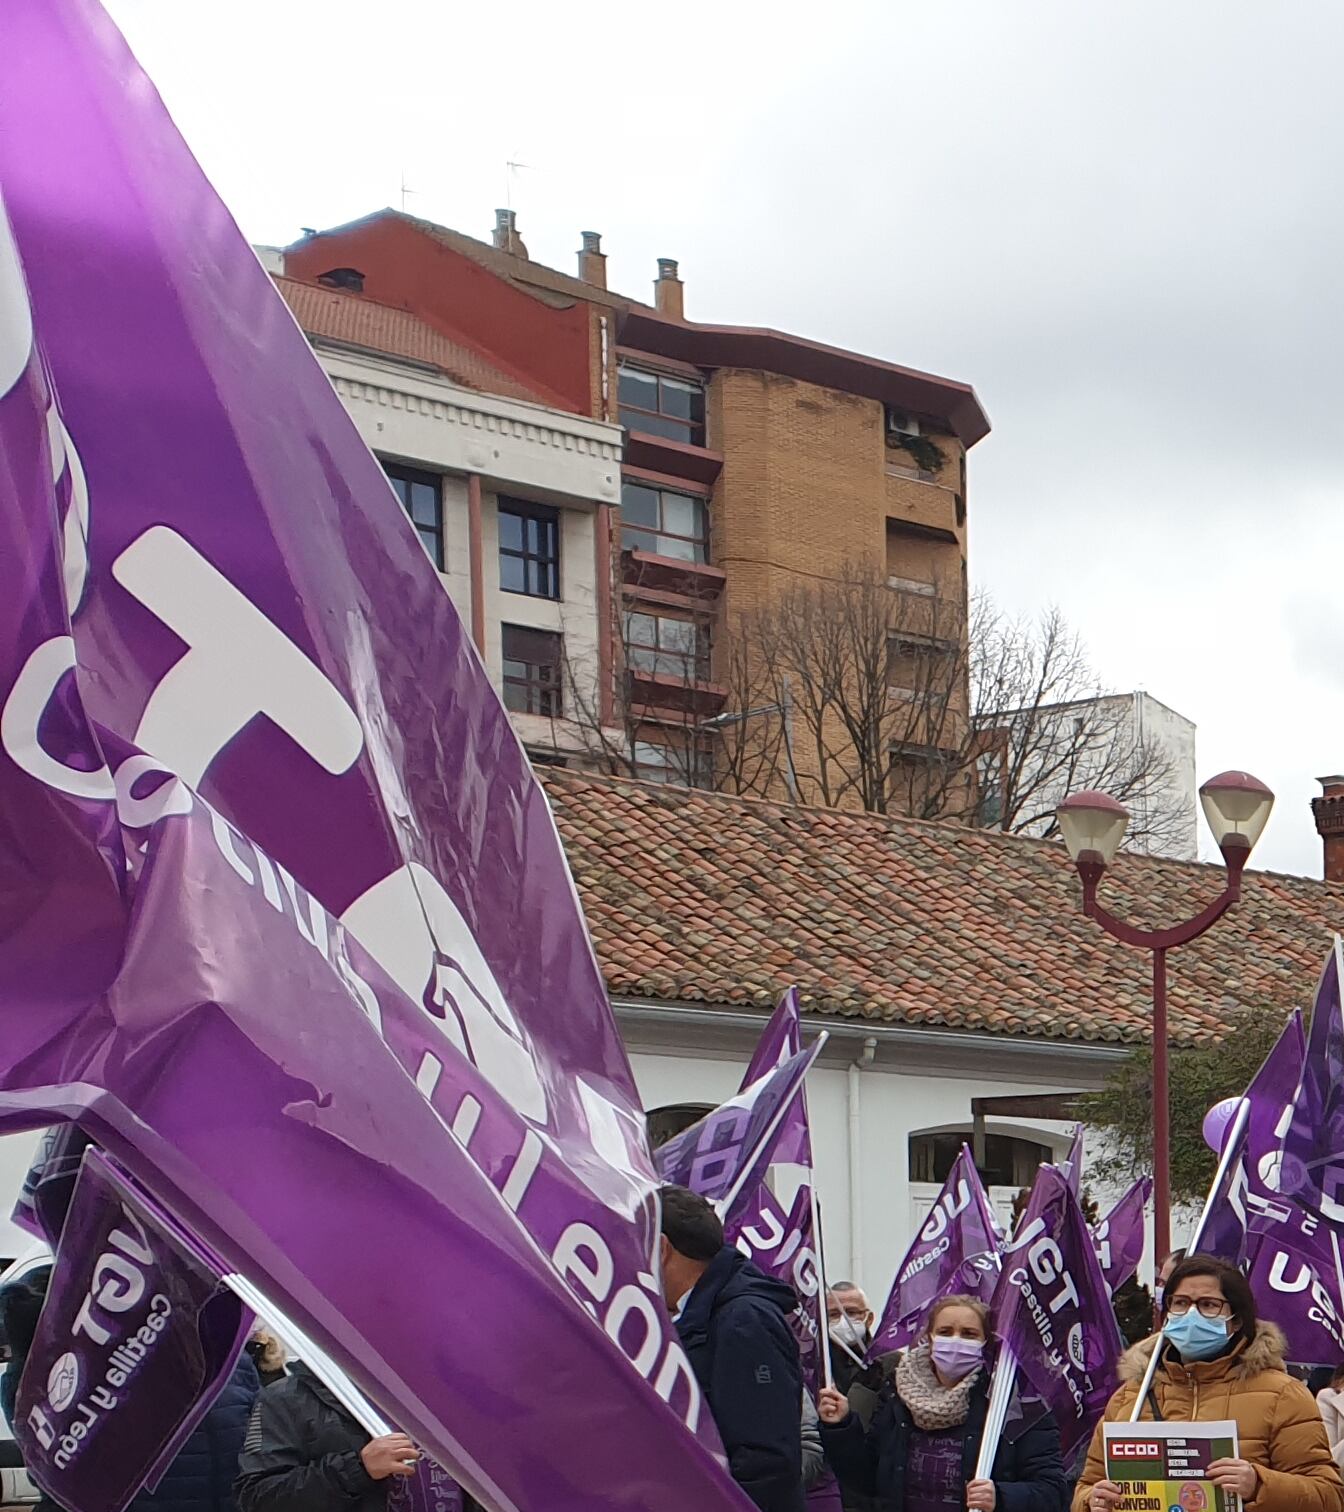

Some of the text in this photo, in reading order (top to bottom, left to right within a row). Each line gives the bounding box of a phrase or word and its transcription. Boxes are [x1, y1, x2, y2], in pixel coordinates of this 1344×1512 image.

[1008, 1267, 1054, 1348] Castilla
[1061, 1365, 1085, 1419] León
[1112, 1444, 1159, 1456] CCOO
[1133, 1482, 1147, 1495] UN
